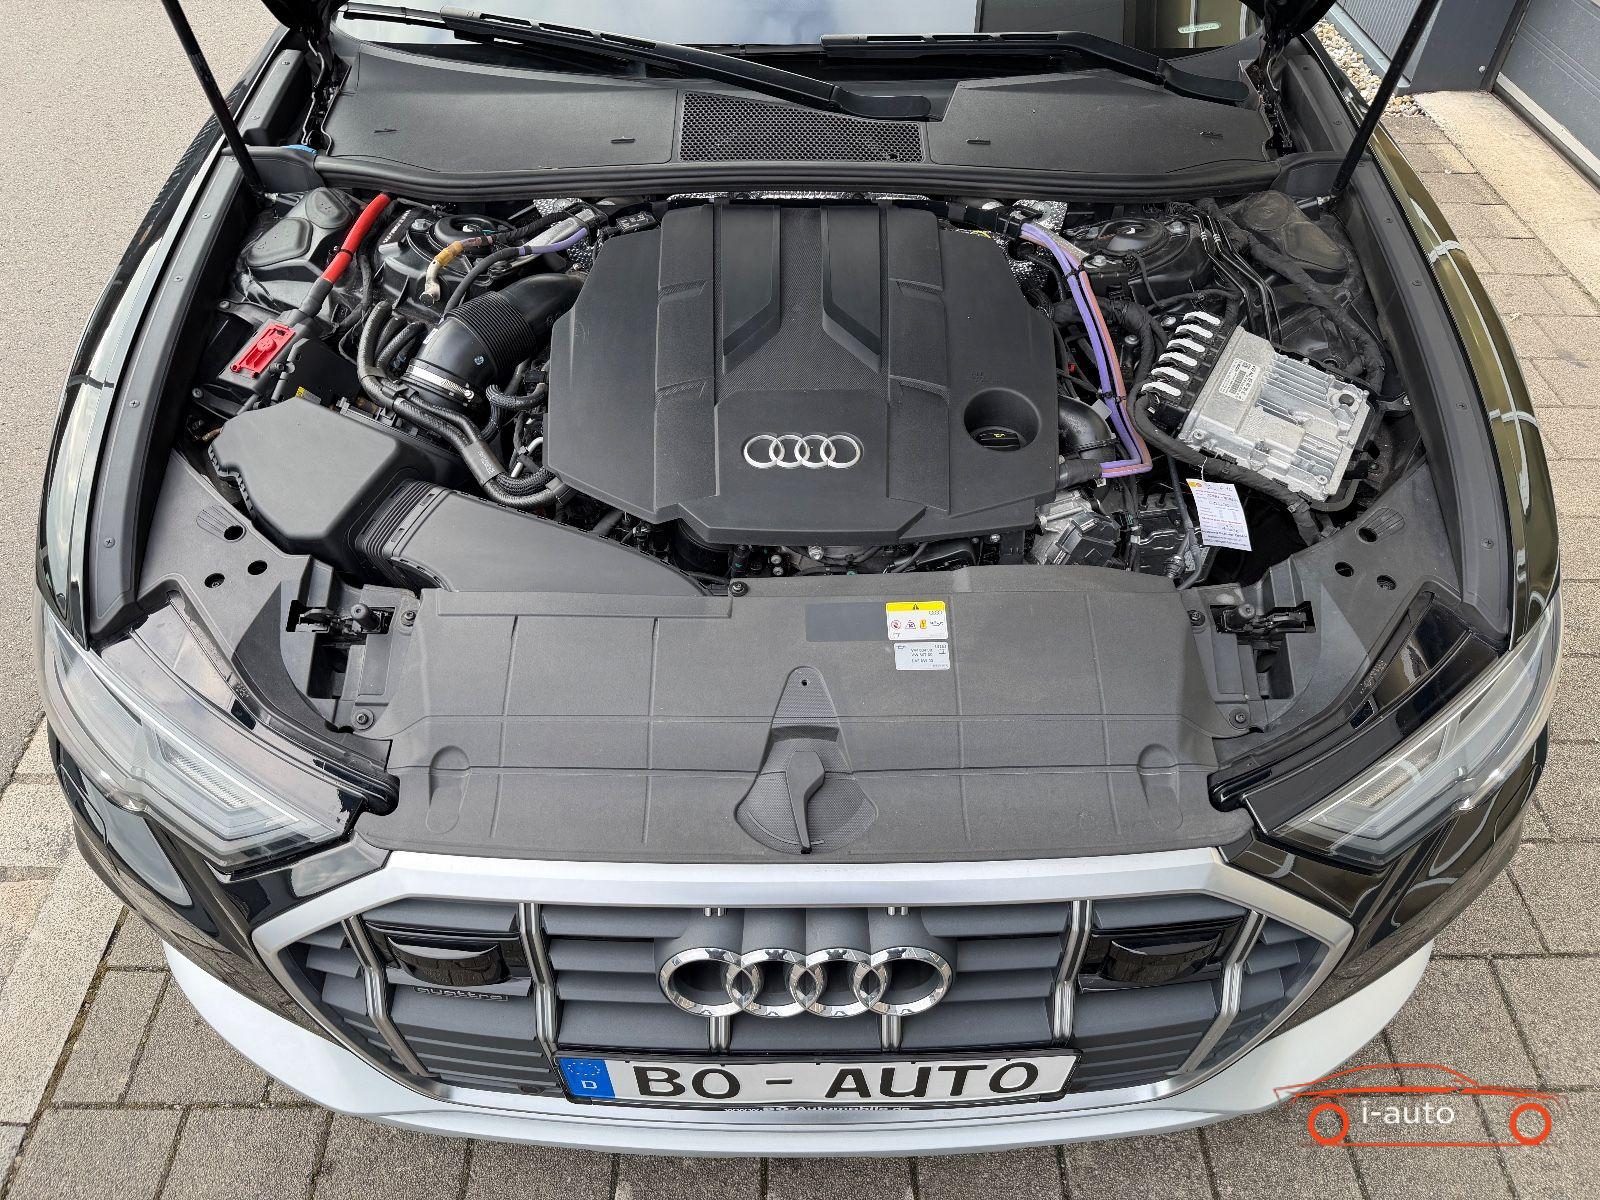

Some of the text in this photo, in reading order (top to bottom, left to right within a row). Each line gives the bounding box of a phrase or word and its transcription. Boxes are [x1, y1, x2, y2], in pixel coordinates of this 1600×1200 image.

[414, 986, 509, 1002] quattro
[581, 1079, 598, 1090] D
[633, 1065, 741, 1100] BO
[824, 1061, 1039, 1099] AUTO
